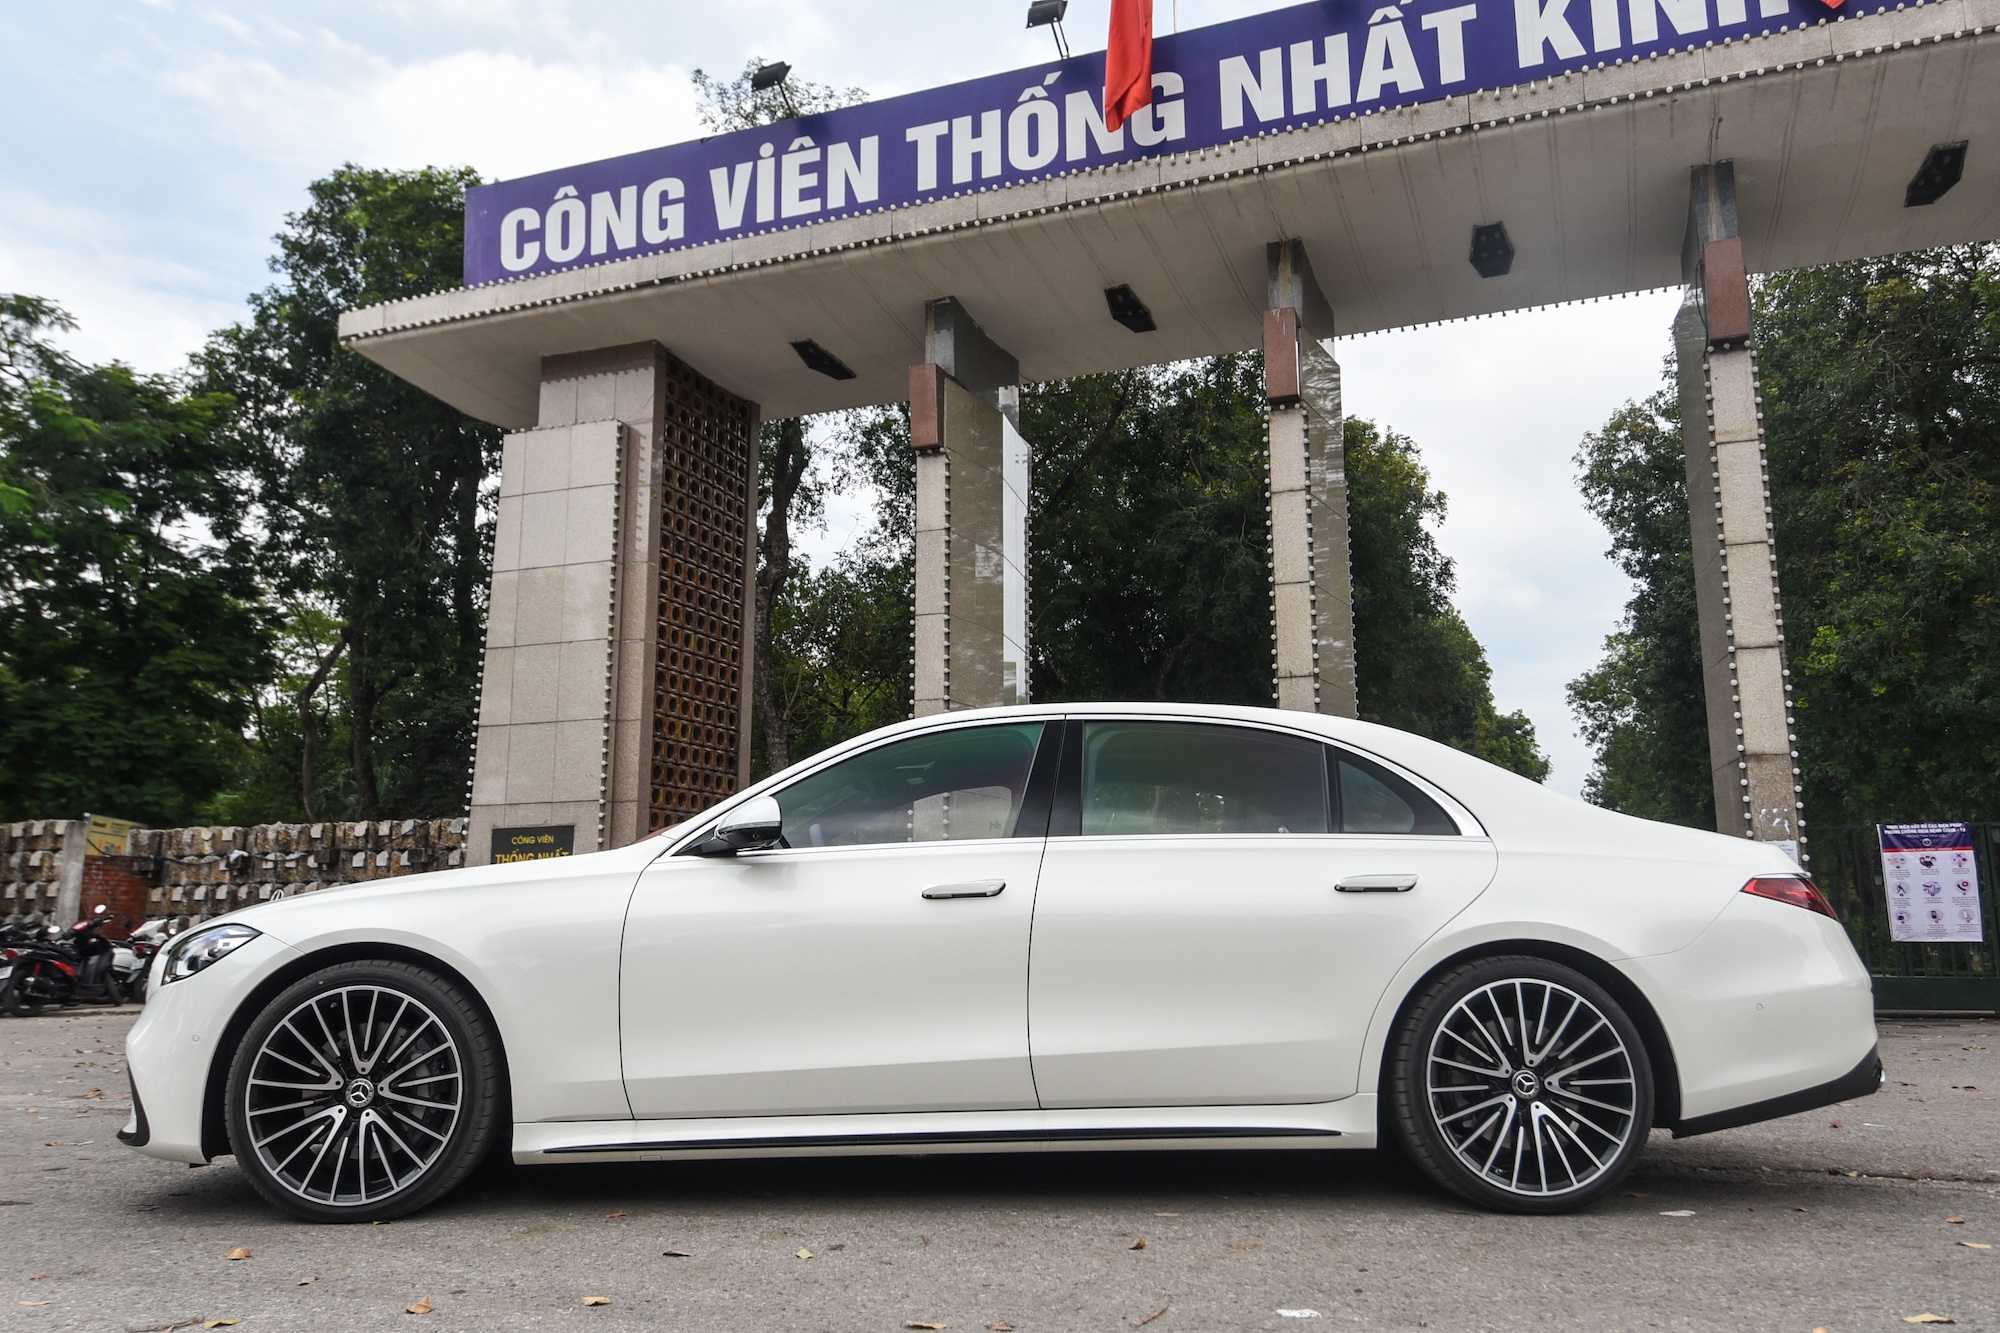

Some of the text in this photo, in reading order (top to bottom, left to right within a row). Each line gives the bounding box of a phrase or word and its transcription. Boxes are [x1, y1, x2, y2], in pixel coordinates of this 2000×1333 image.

[500, 185, 685, 271] CÔNG
[709, 135, 879, 230] VIÊN
[906, 71, 1186, 192] THỐNG
[1218, 0, 1477, 131] NHẤT
[512, 834, 554, 844] CÔNG VIÊN
